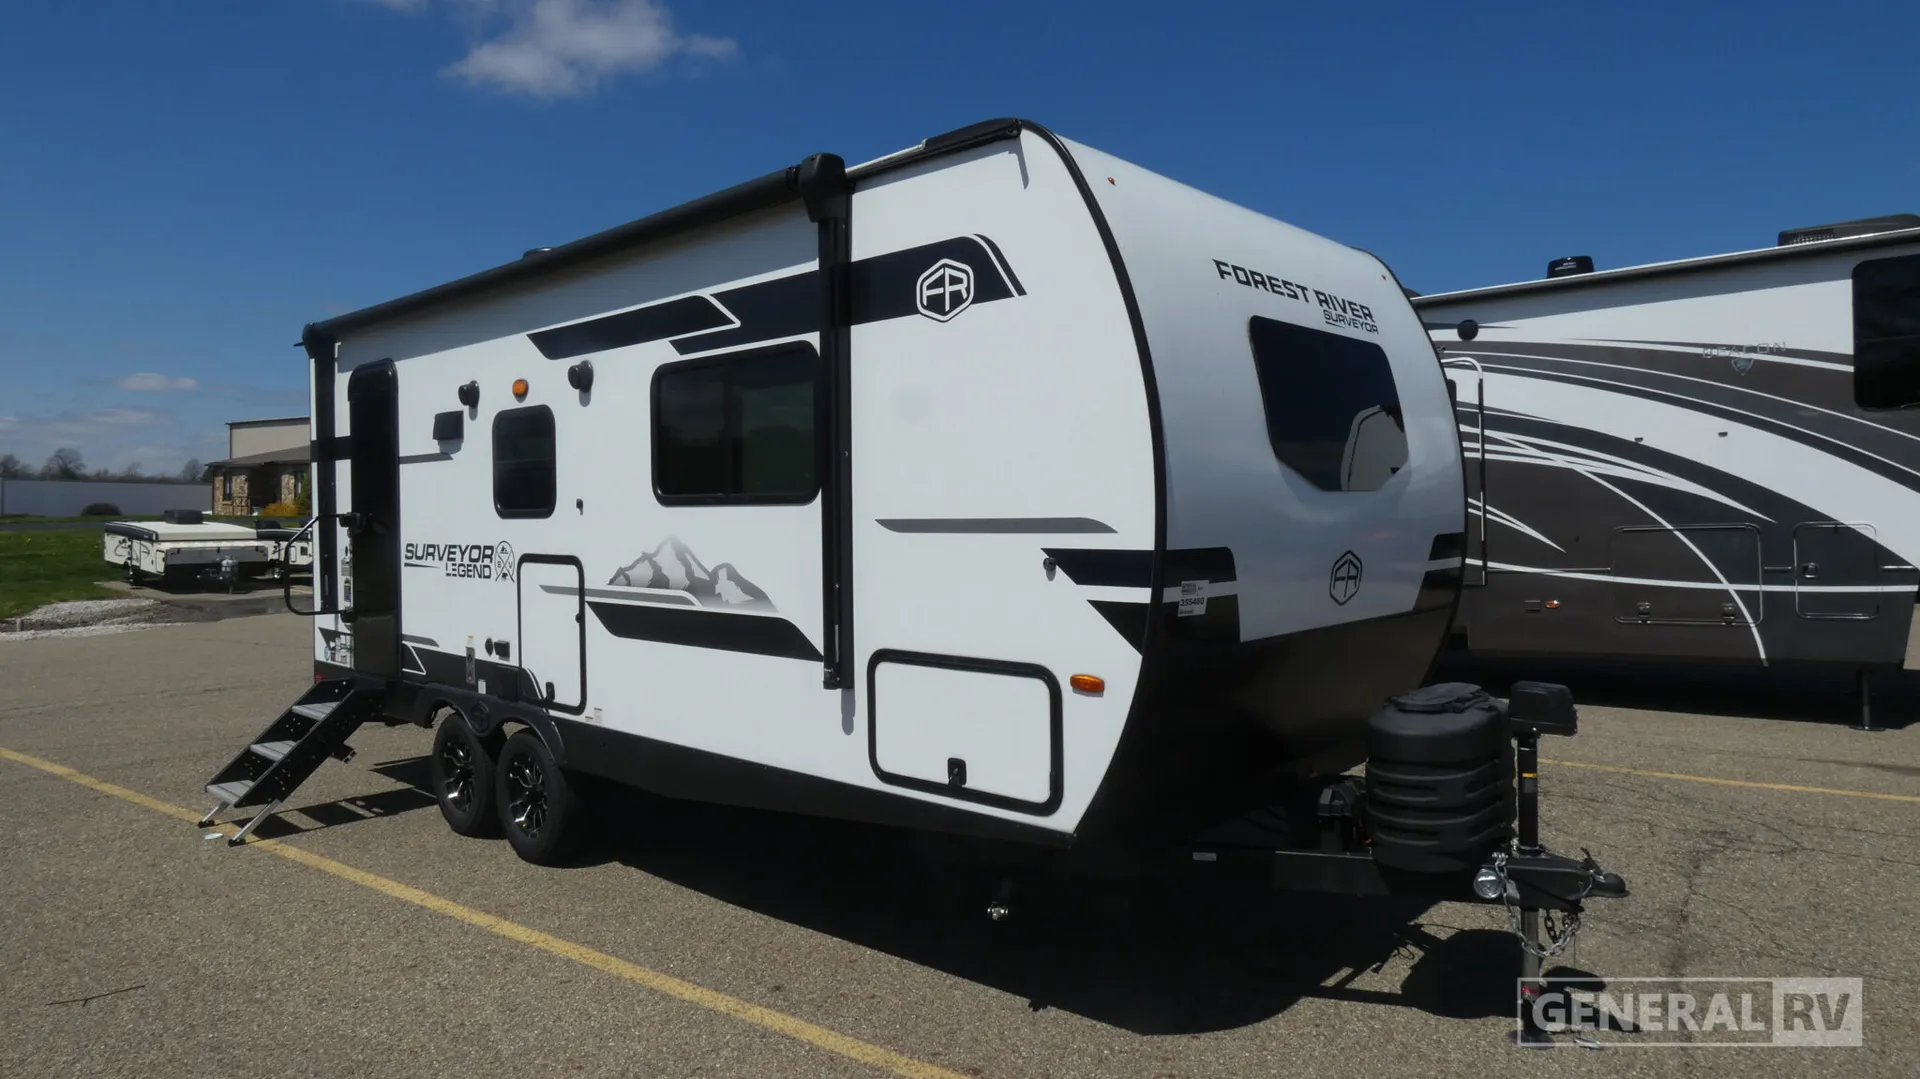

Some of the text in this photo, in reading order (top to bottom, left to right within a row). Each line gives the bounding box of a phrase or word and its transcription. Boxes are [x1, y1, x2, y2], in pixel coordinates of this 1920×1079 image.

[1212, 259, 1376, 323] FOREST RIVER
[1323, 309, 1379, 334] SURVEYOR
[404, 543, 495, 563] SURVEYOR
[445, 562, 492, 579] LEGEND
